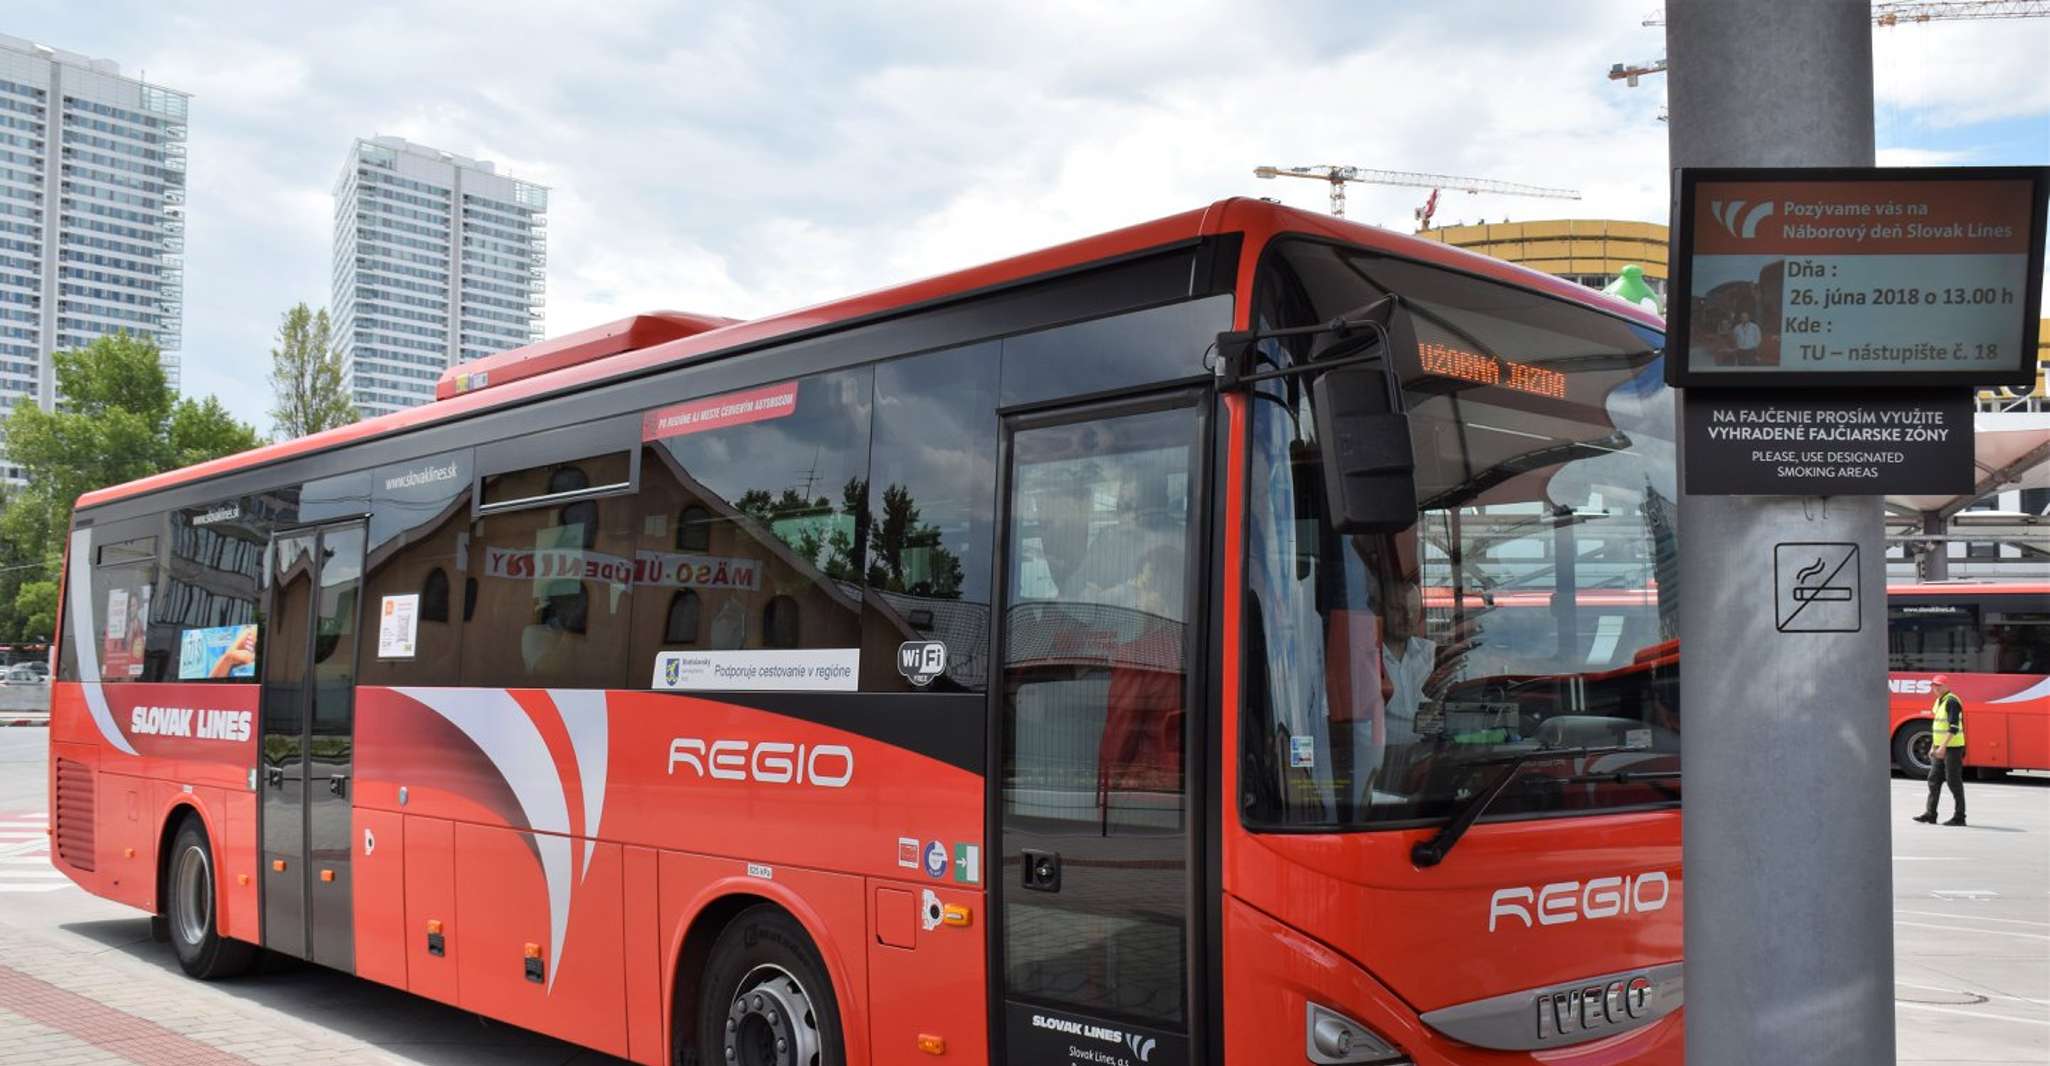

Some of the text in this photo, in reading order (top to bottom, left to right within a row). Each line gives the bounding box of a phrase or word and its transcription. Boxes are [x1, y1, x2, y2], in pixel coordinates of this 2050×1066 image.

[1784, 200, 1928, 219] Pozývame vás na
[1783, 223, 2013, 242] Náborový deň Slovak Lines
[1788, 260, 1825, 278] Dňa
[1790, 287, 2014, 309] 26. júna 2018 o 13.00 h
[1785, 316, 1821, 334] Kde
[1799, 344, 1825, 361] TU
[1848, 342, 1948, 364] nástupište
[1953, 343, 1968, 361] č.
[1975, 344, 1998, 361] 18
[1506, 361, 1566, 399] JAZDA
[1713, 407, 1944, 424] NA FAJČENIE PROSÍM VYUŽITE
[1707, 425, 1949, 441] VYHRADENÉ FAJČIARSKE ZÓNY
[1752, 451, 1904, 463] PLEASE, USE DESIGNATED
[1777, 466, 1879, 478] SMOKING AREAS
[715, 664, 757, 680] Podporuje
[758, 664, 805, 678] cestovanie
[808, 668, 813, 677] v
[816, 664, 851, 680] regióne
[131, 706, 252, 742] SLOVAK LINES
[668, 738, 853, 788] REGIO
[1489, 871, 1670, 933] REGIO
[1537, 976, 1653, 1040] IVECO
[1032, 1015, 1122, 1043] SLOVAK LINES
[1069, 1045, 1095, 1060] Slovak
